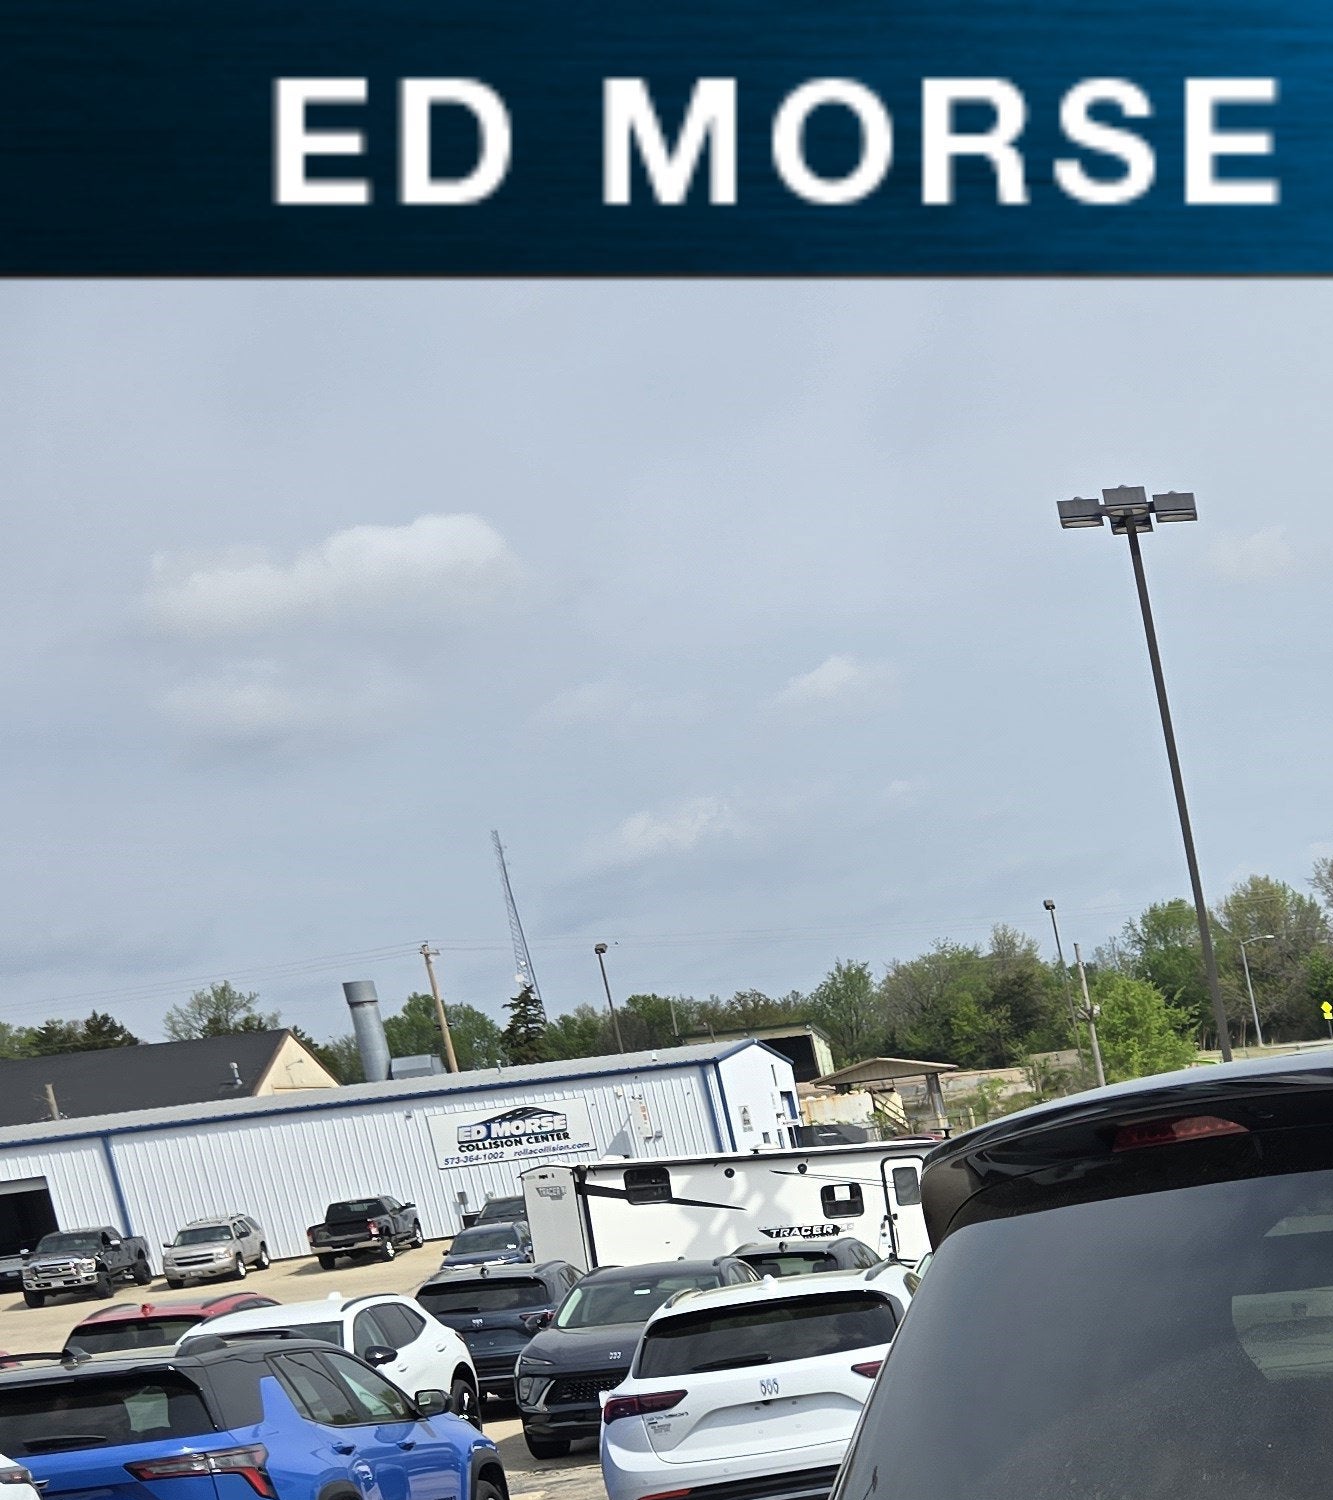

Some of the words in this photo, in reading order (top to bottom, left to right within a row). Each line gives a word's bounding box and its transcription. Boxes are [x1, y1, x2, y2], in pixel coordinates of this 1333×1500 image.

[457, 1124, 487, 1144] ED
[491, 1114, 567, 1139] MORSE
[444, 1151, 505, 1166] 573-364-1002
[513, 1141, 590, 1157] rollacollision.com
[458, 1135, 523, 1153] COLLISION
[526, 1131, 571, 1145] CENTER
[769, 1224, 834, 1238] TRACER
